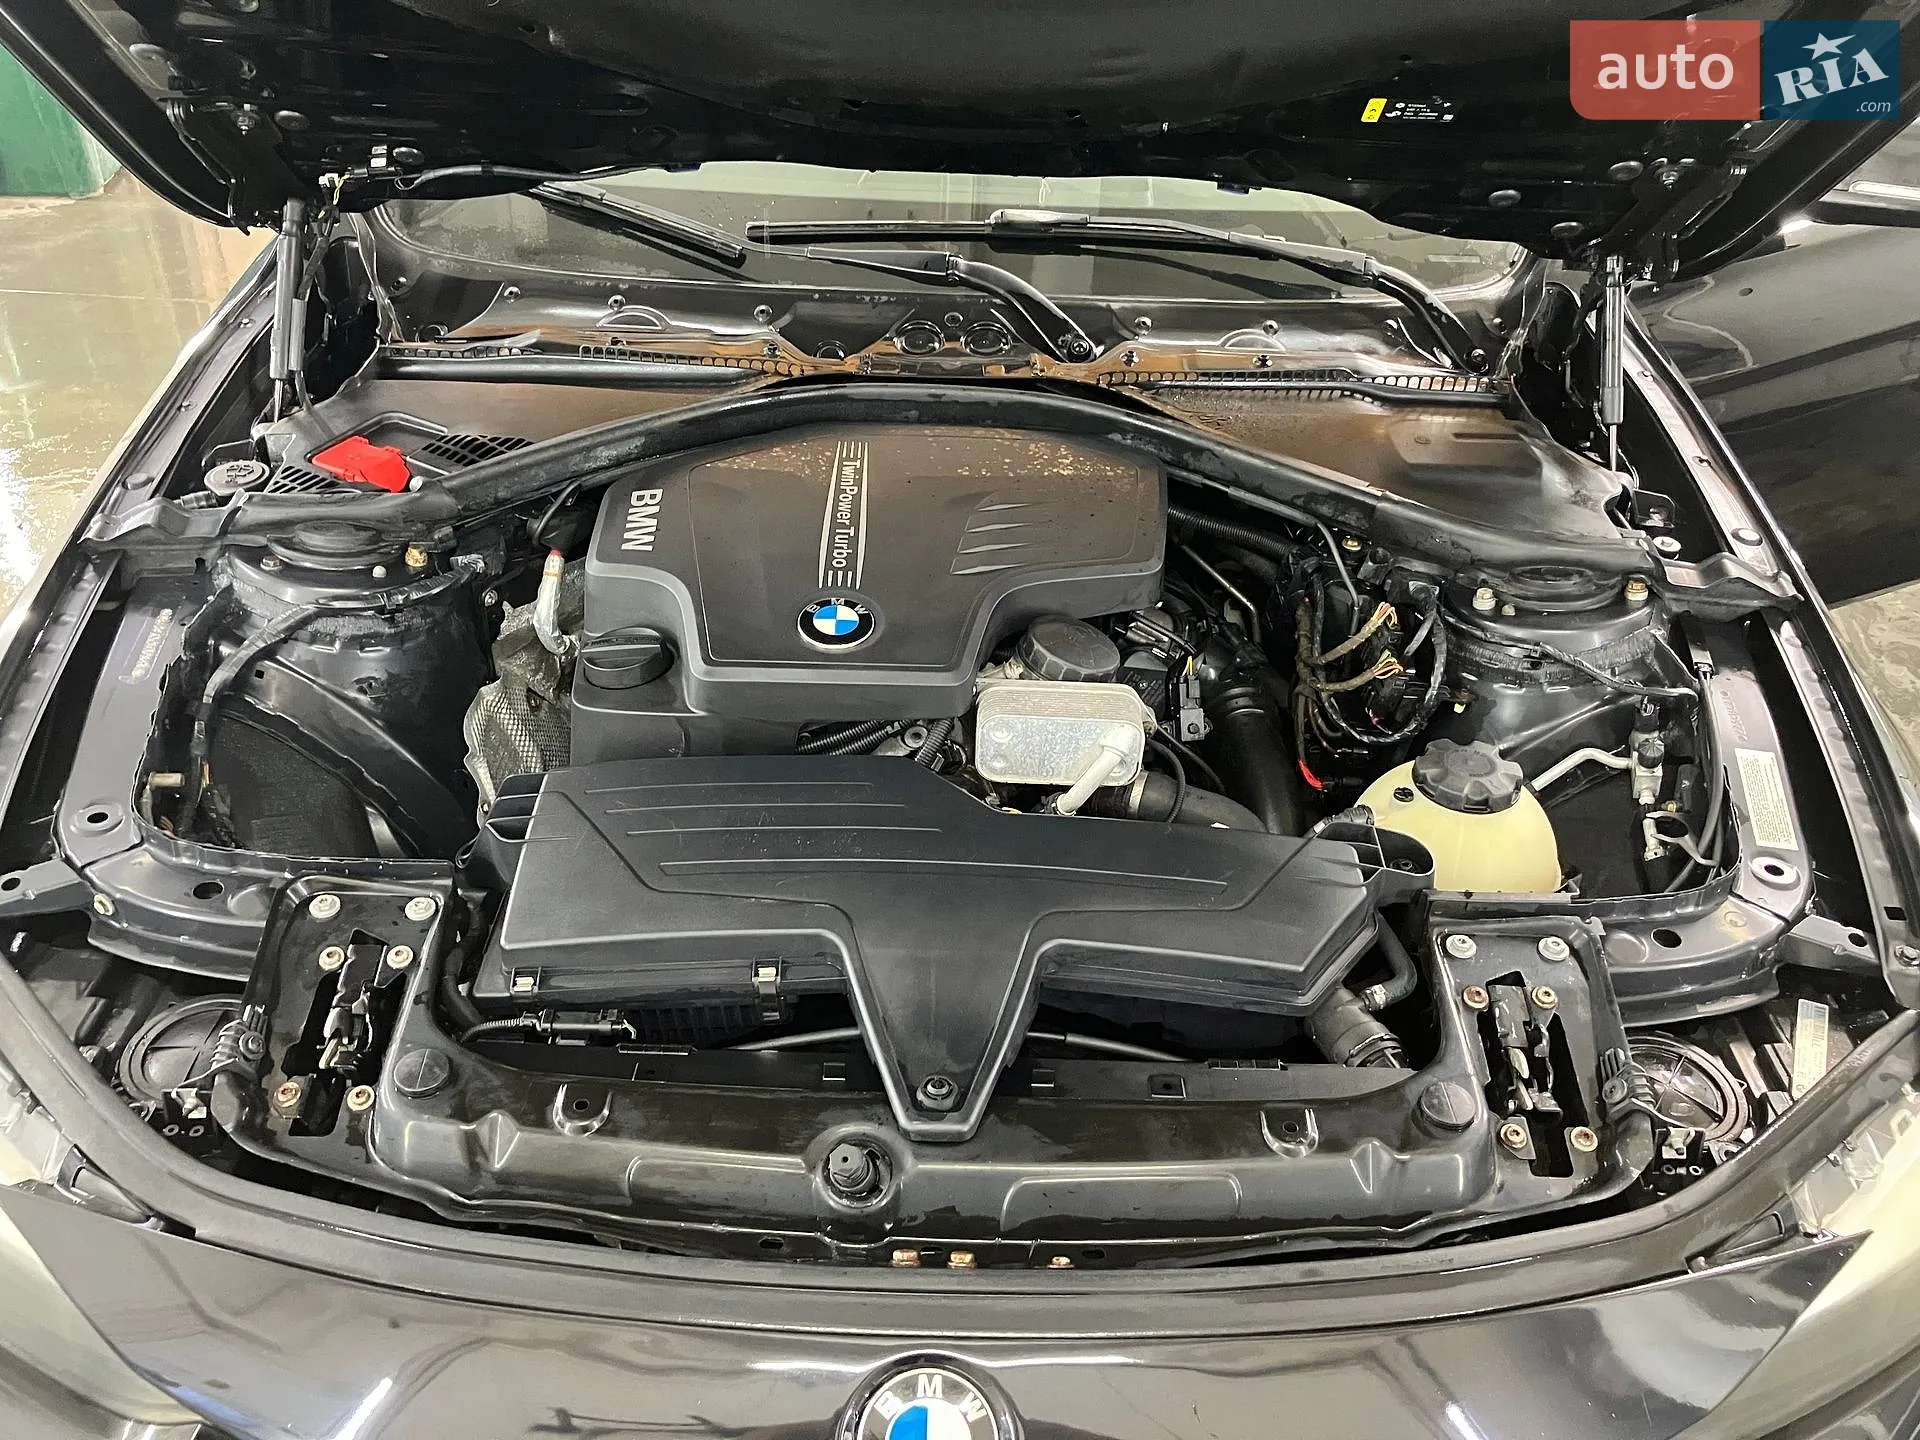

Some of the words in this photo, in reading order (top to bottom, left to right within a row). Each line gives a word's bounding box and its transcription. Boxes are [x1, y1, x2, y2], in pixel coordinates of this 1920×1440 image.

[836, 460, 861, 525] TwinPower
[621, 488, 664, 551] BMW
[832, 526, 855, 568] Turbo
[806, 597, 869, 614] BMW
[873, 1373, 988, 1423] BMW
